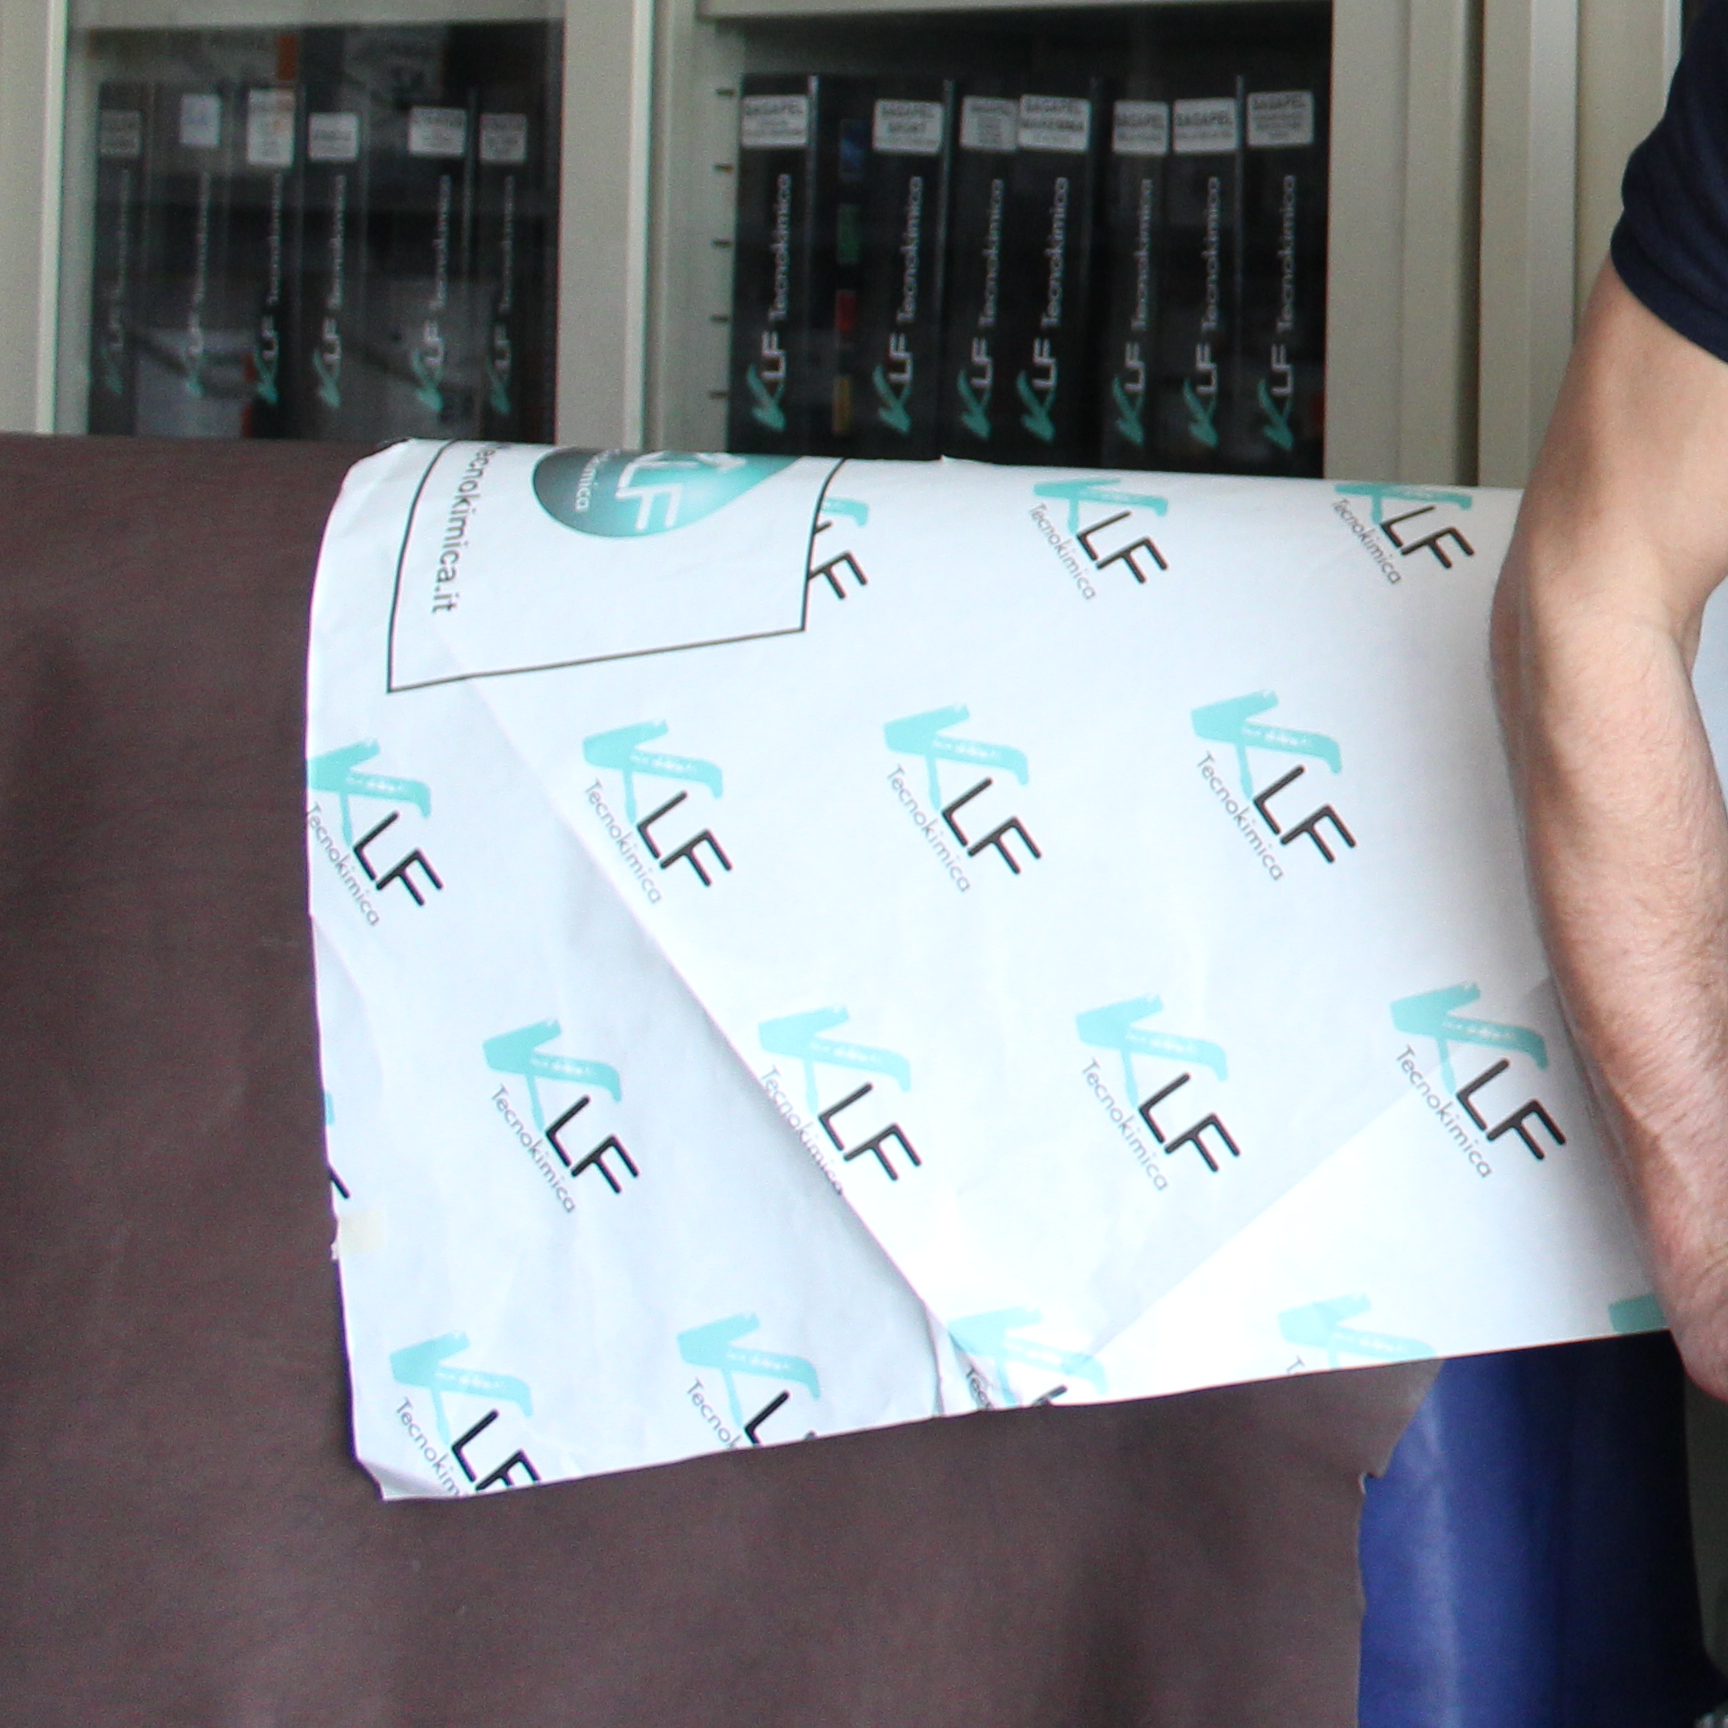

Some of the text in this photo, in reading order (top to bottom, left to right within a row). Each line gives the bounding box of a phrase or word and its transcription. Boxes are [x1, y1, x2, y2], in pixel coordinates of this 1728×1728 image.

[761, 330, 787, 381] LF
[888, 332, 914, 383] LF
[971, 337, 994, 388] LF
[1032, 338, 1057, 390] LF
[1124, 342, 1146, 393] LF
[1195, 342, 1218, 395] LF
[1270, 343, 1294, 396] LF
[807, 518, 870, 600] F
[1028, 502, 1097, 601] Tecnokimica
[1076, 509, 1169, 584] LF
[1331, 498, 1402, 585] Tecnokimica
[1380, 505, 1475, 569] LF
[354, 811, 443, 907] LF
[584, 780, 662, 906] Tecnokimica
[638, 790, 733, 888] LF
[888, 765, 972, 894] Tecnokimica
[942, 777, 1043, 877] LF
[1196, 750, 1285, 882] Tecnokimica
[1253, 764, 1357, 864] LF
[303, 802, 381, 928] Tecnokimica
[491, 1082, 576, 1214] Tecnokimica
[545, 1094, 640, 1195] LF
[818, 1081, 922, 1181] LF
[1078, 1058, 1169, 1192] Tecnokimica
[1138, 1072, 1242, 1174] LF
[1395, 1044, 1494, 1180] Tecnokimica
[1455, 1057, 1568, 1161] LF
